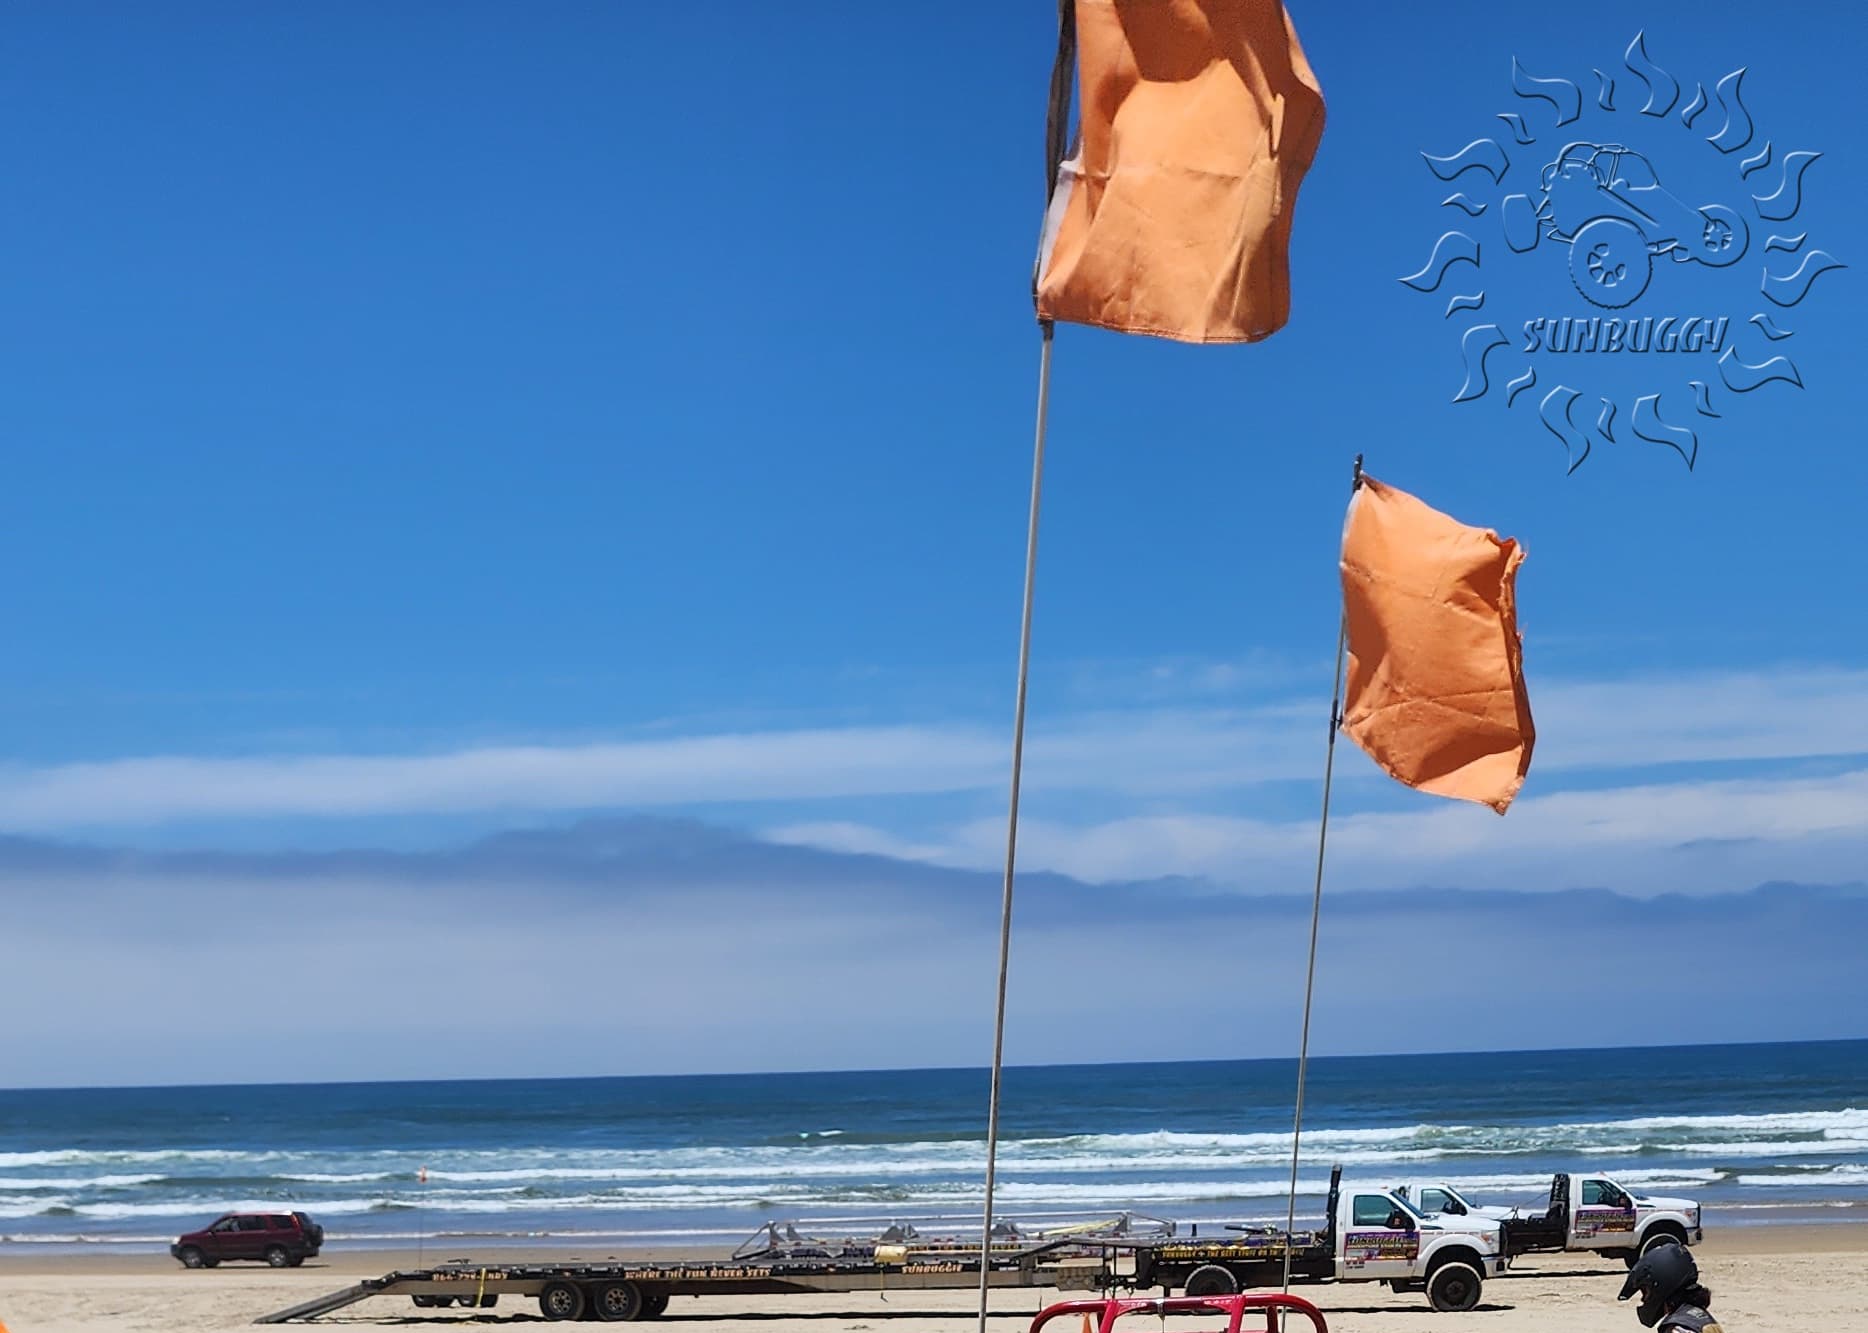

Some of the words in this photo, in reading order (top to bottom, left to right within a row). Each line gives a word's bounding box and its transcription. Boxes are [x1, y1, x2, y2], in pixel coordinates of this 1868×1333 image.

[624, 1270, 661, 1280] WHERE
[664, 1269, 684, 1279] THE
[685, 1269, 707, 1278] FUN
[709, 1268, 744, 1278] NEVER
